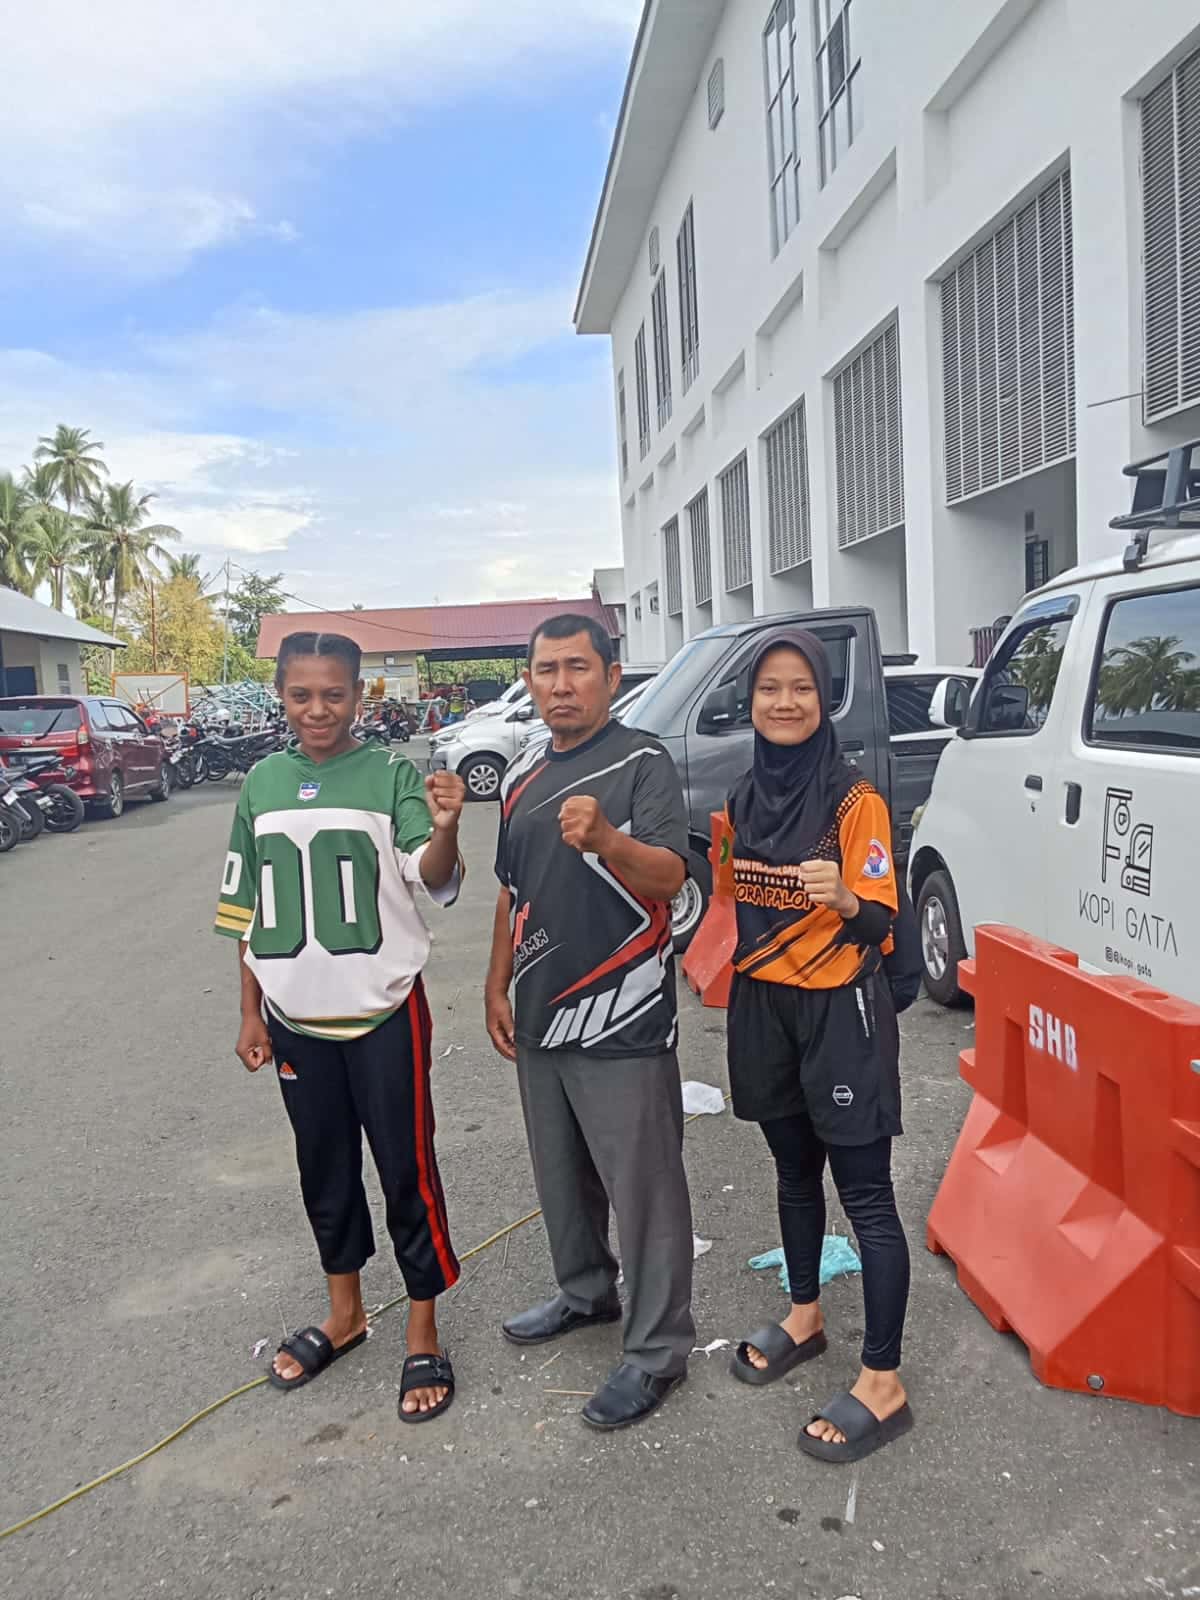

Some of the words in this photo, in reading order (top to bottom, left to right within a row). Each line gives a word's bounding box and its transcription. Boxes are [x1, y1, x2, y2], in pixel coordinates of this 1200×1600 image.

[250, 829, 383, 958] 00
[1079, 887, 1114, 931] KOPI
[1125, 906, 1178, 957] GATA
